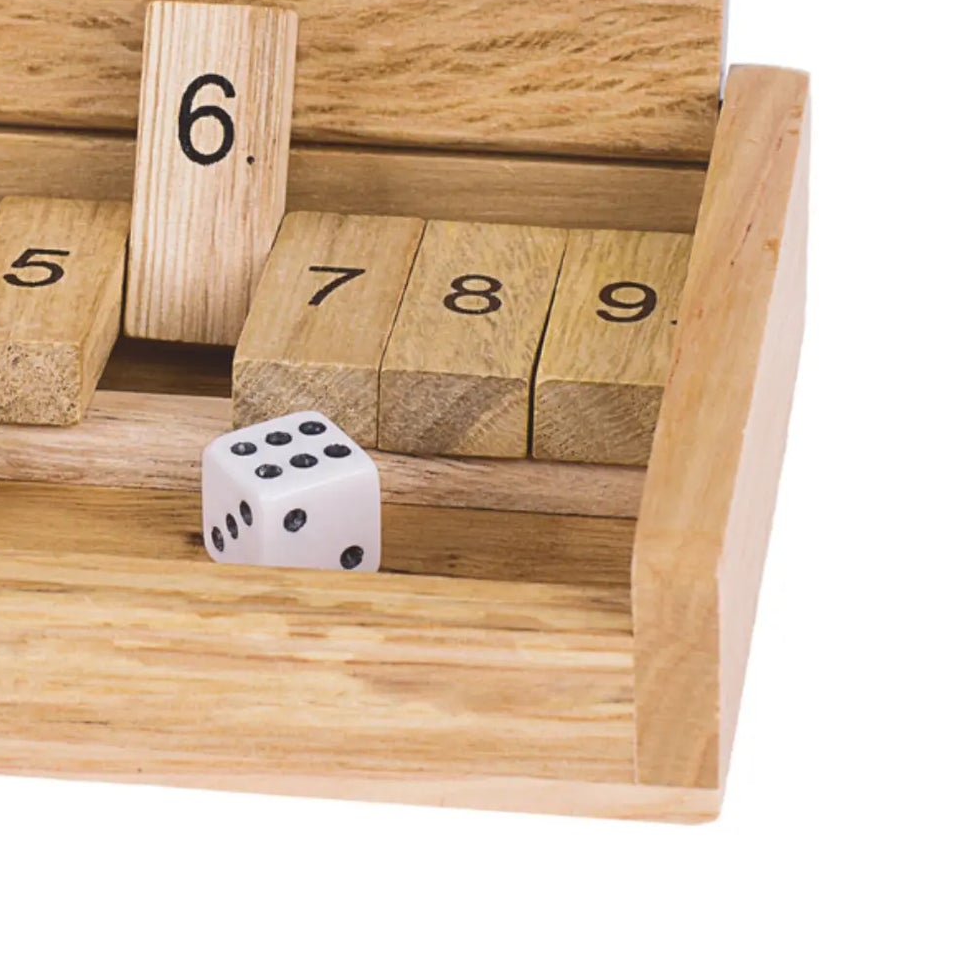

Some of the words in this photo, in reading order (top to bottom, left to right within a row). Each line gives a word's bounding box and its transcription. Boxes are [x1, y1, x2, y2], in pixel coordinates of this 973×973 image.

[2, 247, 70, 288] 5
[307, 265, 367, 307] 7
[442, 274, 503, 316] 8
